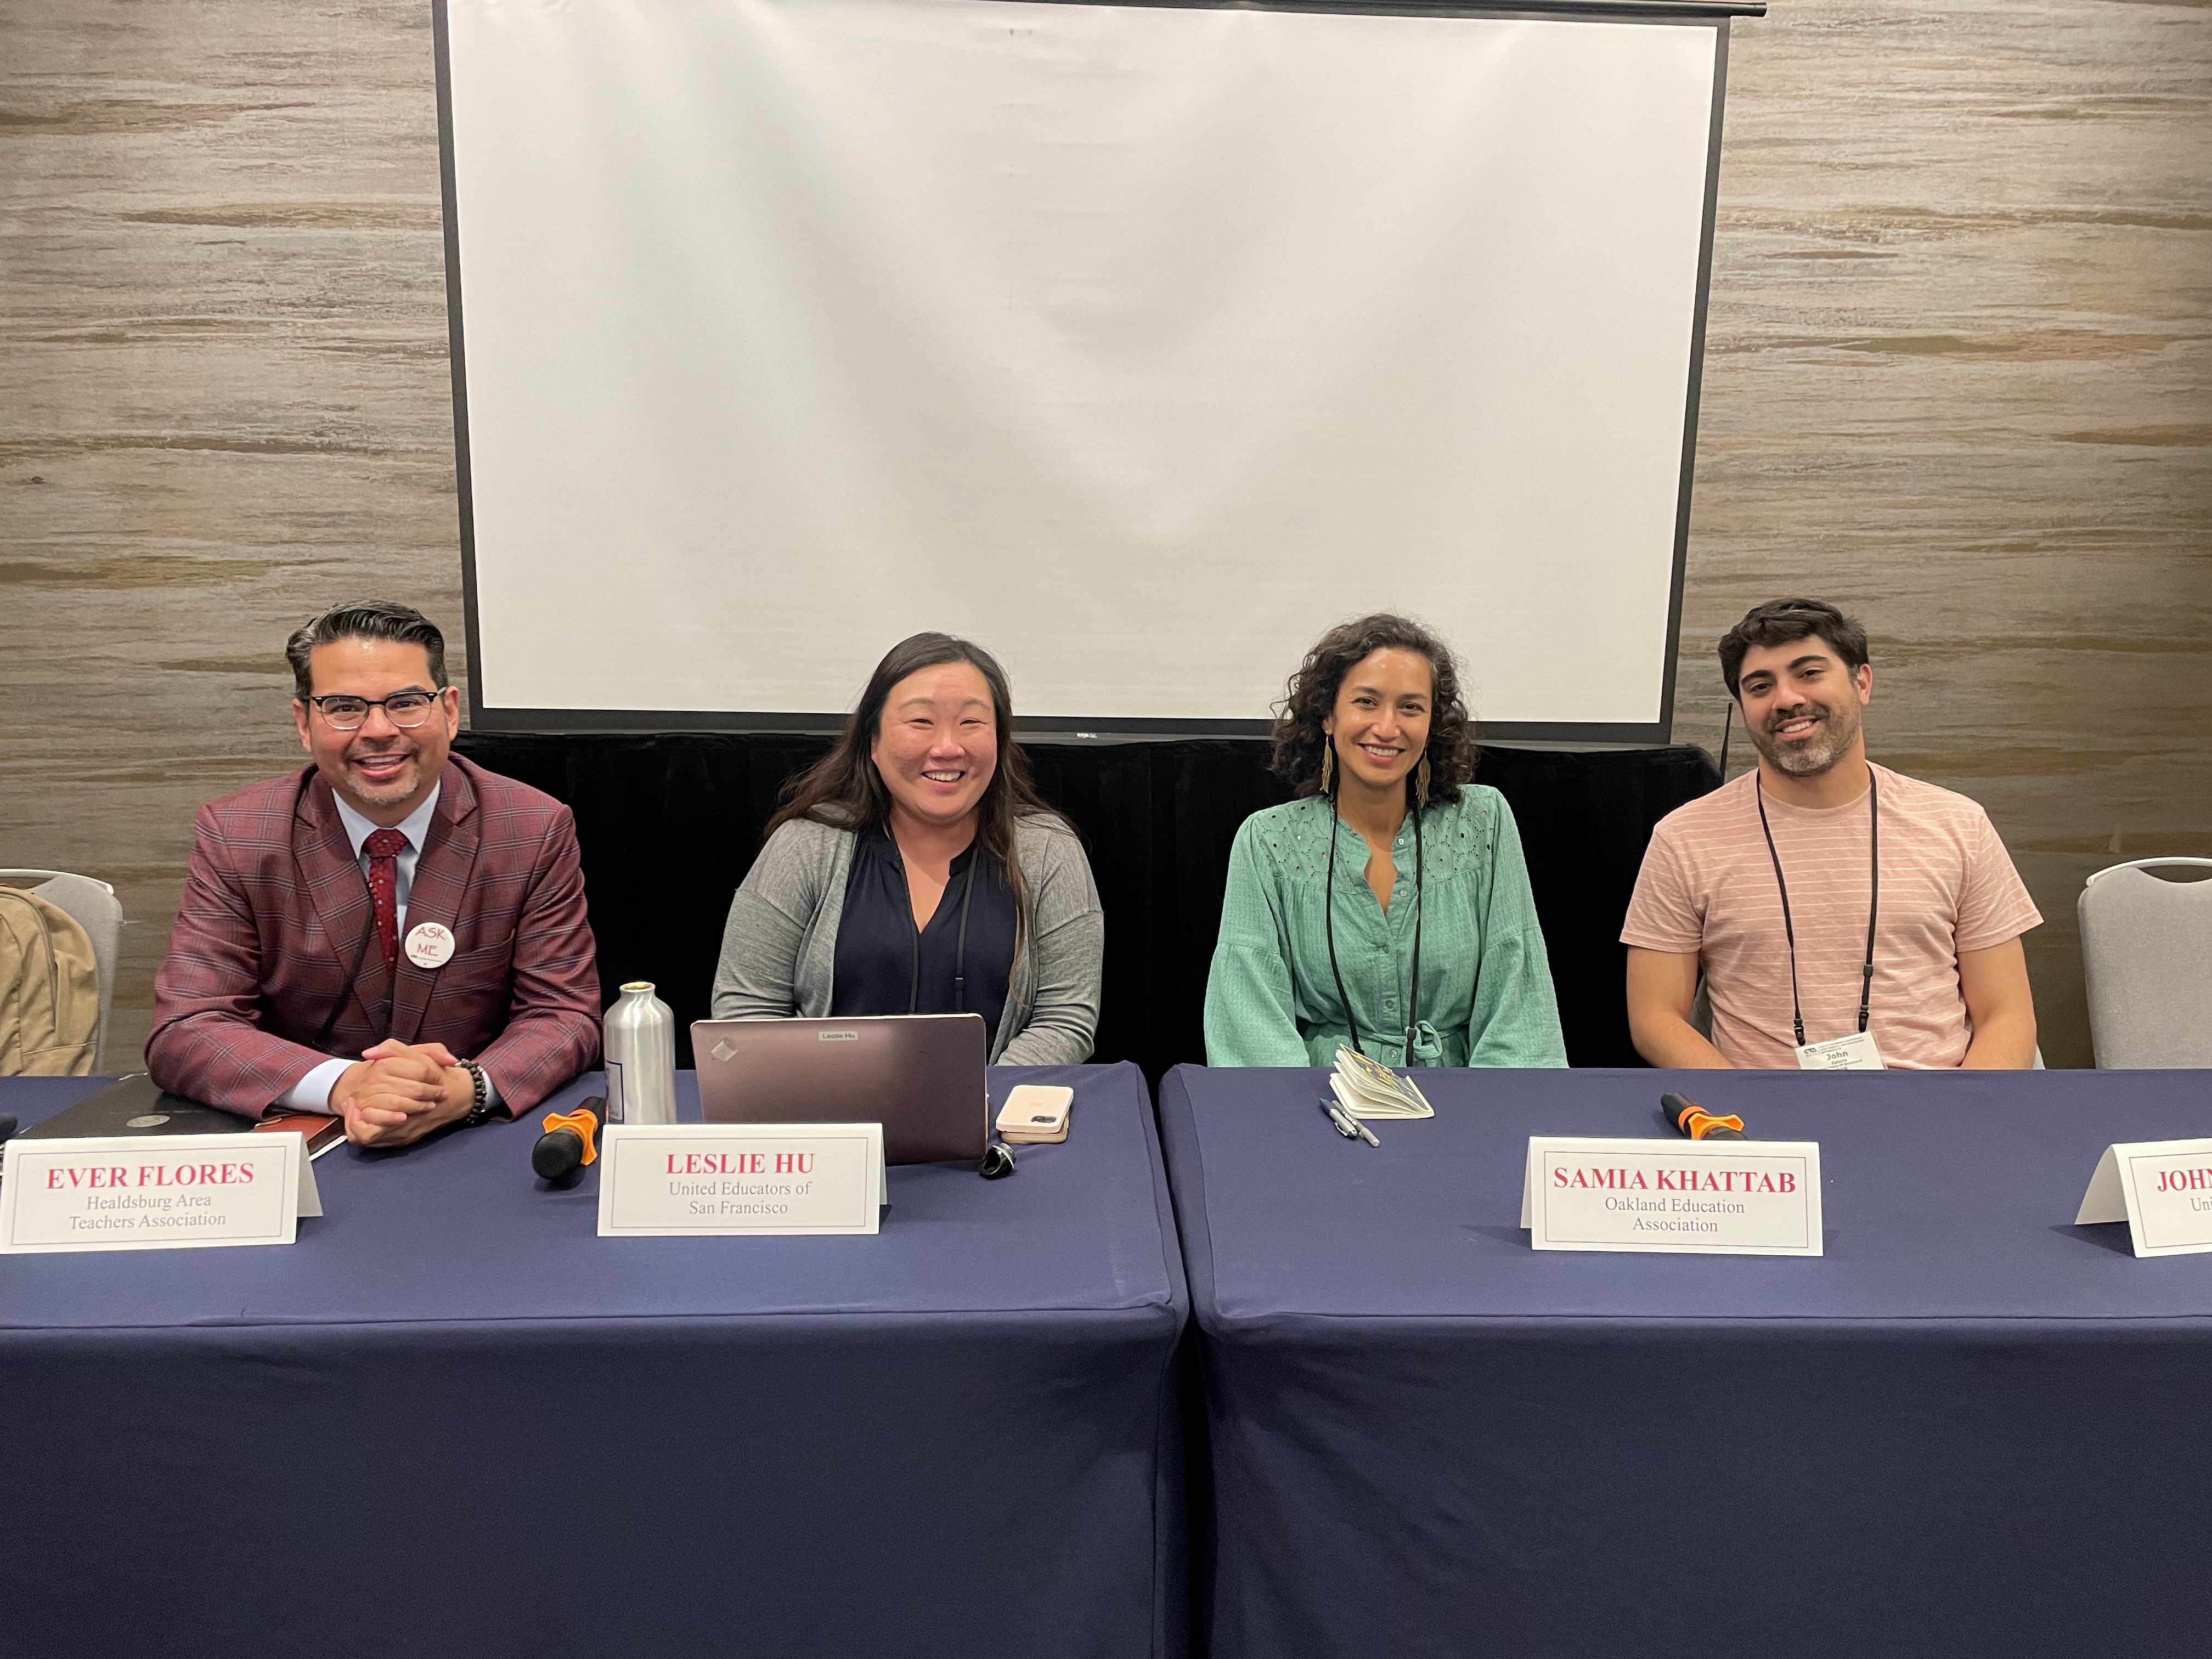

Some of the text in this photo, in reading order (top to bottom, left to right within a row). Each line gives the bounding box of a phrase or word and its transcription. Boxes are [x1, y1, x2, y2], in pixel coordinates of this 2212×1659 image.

[415, 927, 446, 940] ASK
[417, 944, 438, 956] ME
[1826, 1051, 1849, 1060] John
[666, 1153, 815, 1174] LESLIE HU
[47, 1163, 255, 1189] EVER FLORES
[1554, 1167, 1796, 1193] SAMIA KHATTAB
[670, 1181, 811, 1195] United Educators of
[87, 1194, 212, 1211] Healdsburg Area
[689, 1200, 788, 1215] San Francisco
[1605, 1197, 1745, 1214] Oakland Education
[69, 1212, 226, 1229] Teachers Association
[1632, 1217, 1719, 1232] Association
